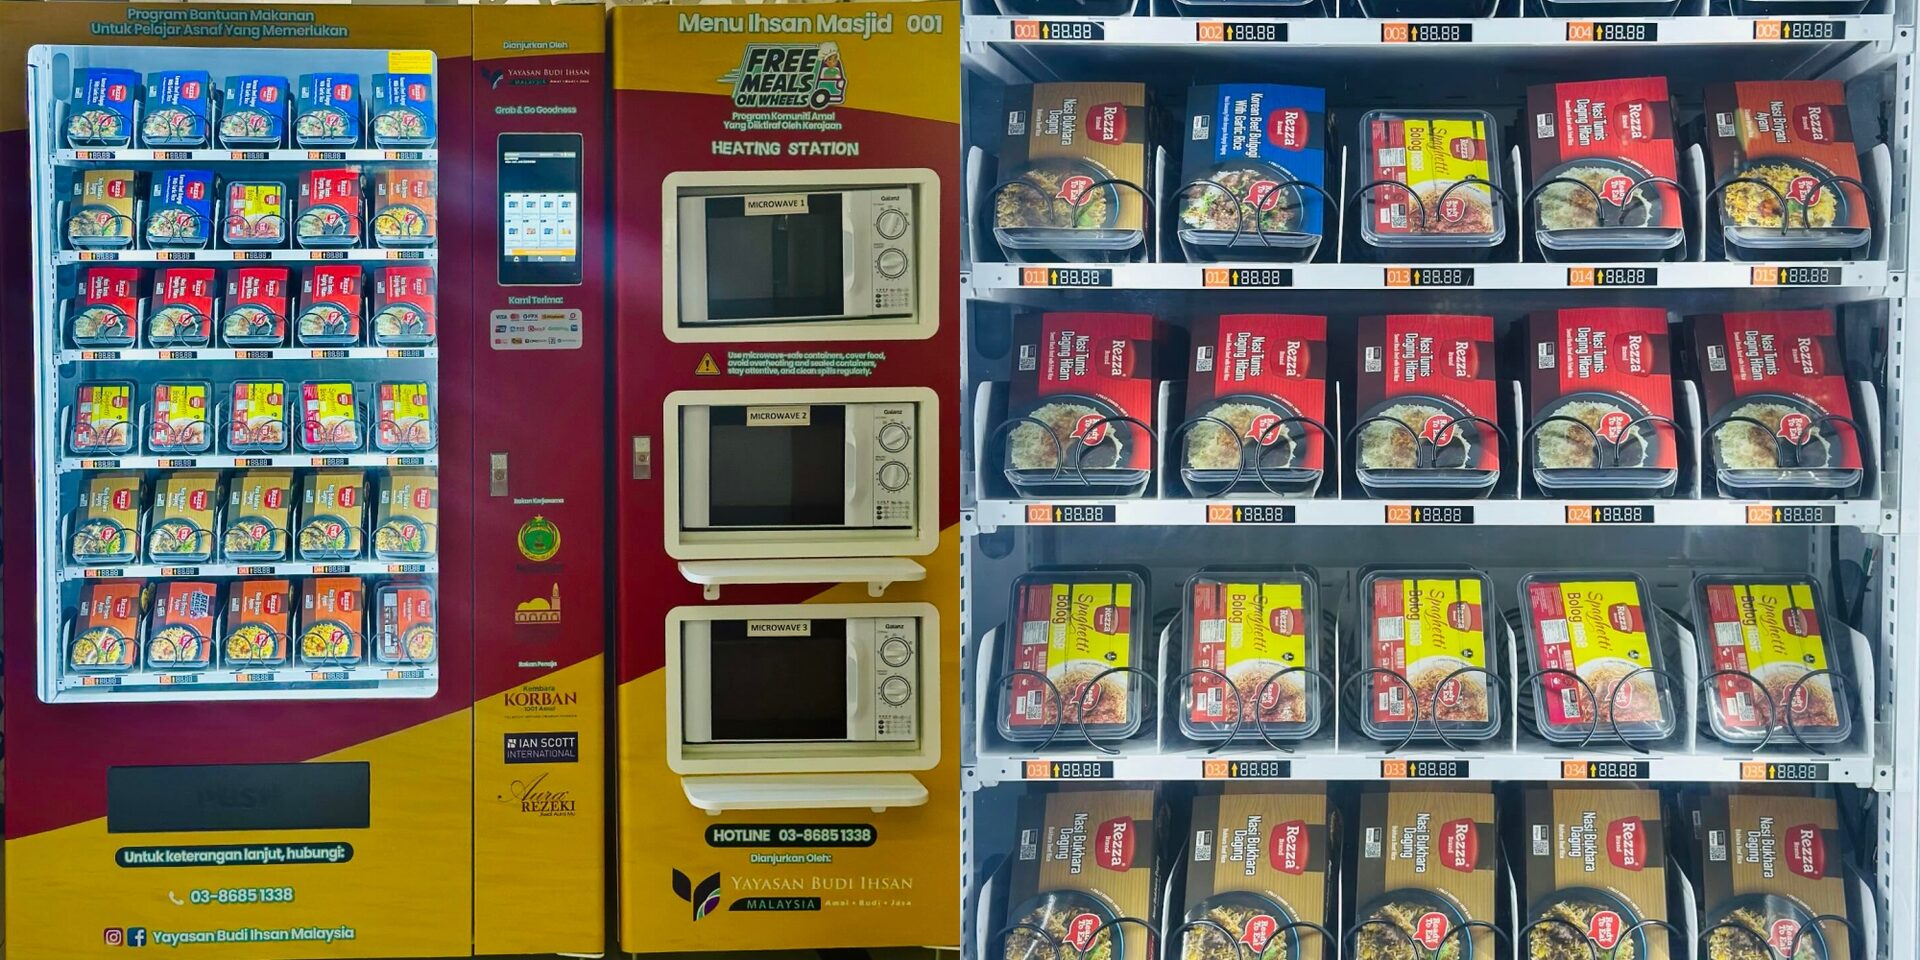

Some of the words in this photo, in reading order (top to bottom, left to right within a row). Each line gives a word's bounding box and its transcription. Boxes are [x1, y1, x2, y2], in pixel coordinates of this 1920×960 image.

[127, 8, 187, 23] Program
[189, 9, 248, 21] Bantuan
[250, 10, 314, 22] Makanan
[91, 22, 132, 36] Untuk
[134, 23, 181, 40] Pelajar
[183, 24, 224, 36] Asnaf
[224, 24, 260, 40] Yang
[262, 24, 348, 37] Memerlukan
[678, 13, 744, 33] Menu
[748, 14, 812, 33] Ihsan
[816, 12, 893, 40] Masjid
[906, 15, 943, 33] 001
[1015, 24, 1038, 38] 001
[1052, 24, 1092, 39] 88.88
[1199, 25, 1222, 39] 002
[1236, 25, 1276, 40] 88.88
[1384, 26, 1406, 40] 003
[1420, 26, 1460, 40] 88.88
[1568, 25, 1593, 39] 004
[1605, 25, 1646, 40] 88.88
[1756, 24, 1780, 38] 005
[1792, 24, 1833, 38] 88.88
[503, 41, 548, 50] Dianjurkan
[746, 48, 820, 72] FREE
[740, 74, 814, 93] MEALS
[736, 94, 757, 106] ON
[758, 94, 810, 106] WHEELS
[1064, 98, 1078, 114] Nasi
[1234, 100, 1248, 114] With
[1250, 93, 1264, 116] Korean
[495, 106, 516, 114] Grab
[517, 106, 524, 114] &
[524, 106, 536, 114] Go
[536, 106, 577, 114] Goodness
[1574, 99, 1591, 124] Daging
[1592, 102, 1606, 118] Nasi
[1770, 101, 1786, 117] Nasi
[724, 120, 747, 132] Yang
[748, 120, 782, 130] Diiktiraf
[782, 120, 802, 130] Oleh
[802, 120, 842, 132] Kerajaan
[732, 112, 770, 124] Program
[771, 112, 810, 121] Komuniti
[812, 112, 836, 121] Amal
[1045, 110, 1062, 135] Daging
[1103, 106, 1118, 140] Rezza
[1234, 116, 1246, 135] Garlic
[1250, 117, 1262, 132] Beef
[1628, 104, 1642, 138] Rezza
[1754, 112, 1770, 132] Ayam
[1808, 106, 1824, 140] Rezza
[1062, 116, 1076, 145] Bukhara
[1284, 112, 1298, 146] Rezza
[1578, 125, 1592, 146] Hitam
[1594, 119, 1608, 140] Tumis
[1771, 118, 1790, 143] Briyani
[712, 140, 781, 156] HEATING
[788, 141, 860, 156] STATION
[1232, 136, 1246, 150] Rice
[1245, 132, 1262, 158] Bulgogi
[748, 200, 798, 209] MICROWAVE
[508, 296, 531, 304] Kami
[532, 296, 564, 304] Terima:
[1233, 332, 1251, 358] Daging
[1252, 336, 1266, 352] Nasi
[750, 360, 794, 368] overheating
[804, 352, 845, 360] containers,
[867, 352, 886, 360] food,
[1286, 341, 1300, 376] Rezza
[1235, 360, 1250, 381] Hitam
[1250, 354, 1264, 376] Tumis
[750, 412, 801, 420] MICROWAVE
[1029, 509, 1052, 521] 021
[1064, 508, 1103, 521] 88.88
[1210, 509, 1232, 521] 022
[1244, 508, 1283, 521] 88.88
[1388, 509, 1410, 521] 023
[1423, 508, 1462, 522] 88.88
[751, 624, 801, 632] MICROWAVE
[1584, 591, 1613, 651] Spaghetti
[504, 692, 577, 706] KORBAN
[519, 738, 538, 748] IAN
[541, 738, 575, 747] SCOTT
[507, 750, 575, 758] INTERNATIONAL
[522, 801, 575, 812] REZEKI
[1417, 813, 1430, 832] Nasi
[714, 830, 770, 842] HOTLINE
[779, 829, 838, 842] 03-8685
[841, 829, 871, 841] 1338
[1400, 827, 1416, 858] Daging
[1455, 824, 1468, 866] Rezza
[124, 850, 164, 863] Untuk
[166, 849, 242, 864] keterangan
[244, 848, 286, 864] lanjut,
[286, 845, 345, 862] hubungi:
[751, 854, 804, 865] Dianjurkan
[806, 854, 833, 863] Oleh:
[1416, 835, 1430, 872] Bukhara
[731, 877, 804, 890] YAYASAN
[811, 877, 853, 890] BUDI
[861, 877, 913, 889] IHSAN
[190, 889, 257, 903] 03-8685
[259, 888, 293, 902] 1338
[746, 900, 815, 910] MALAYSIA
[152, 930, 215, 946] Yayasan
[217, 928, 247, 942] Budi
[251, 928, 289, 942] Ihsan
[292, 926, 355, 943] Malaysia
